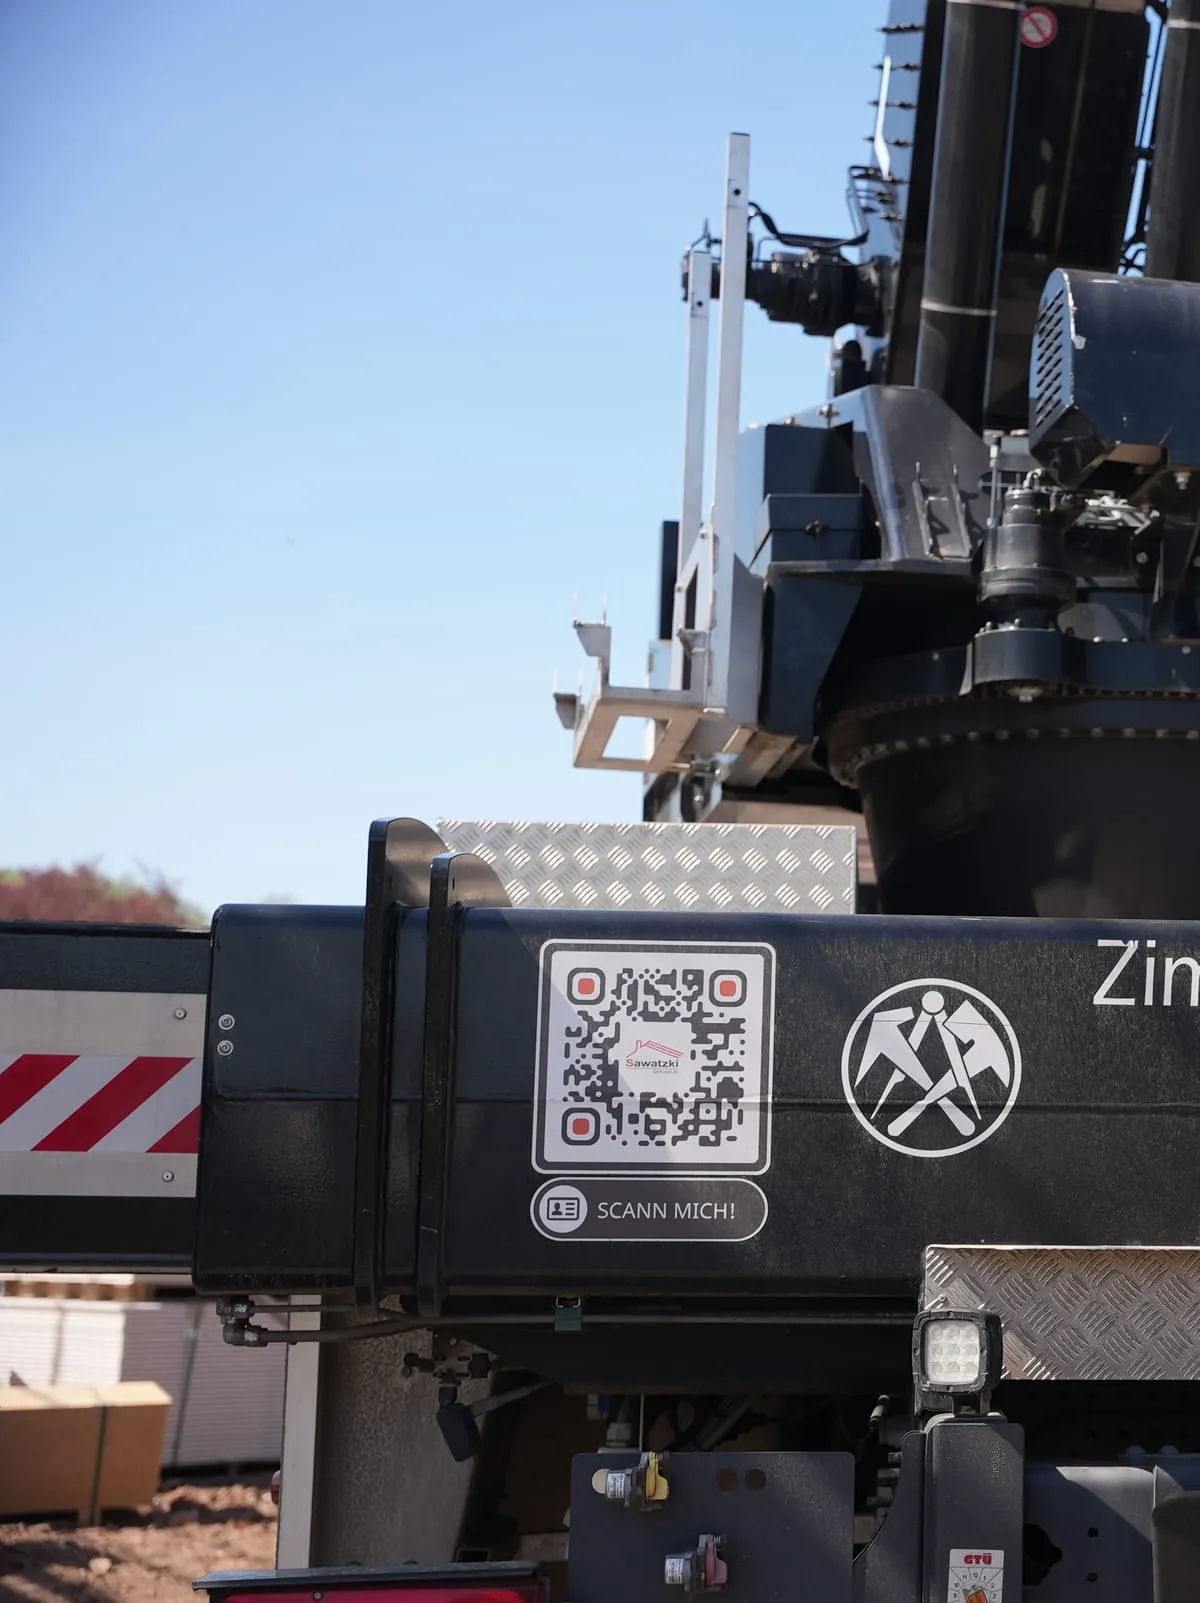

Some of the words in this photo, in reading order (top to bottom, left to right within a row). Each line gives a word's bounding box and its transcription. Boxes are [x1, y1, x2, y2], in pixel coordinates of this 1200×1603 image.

[625, 1058, 679, 1068] Sawatzki
[597, 1201, 667, 1220] SCANN
[674, 1201, 735, 1220] MICH!
[964, 1553, 992, 1565] GTÜ
